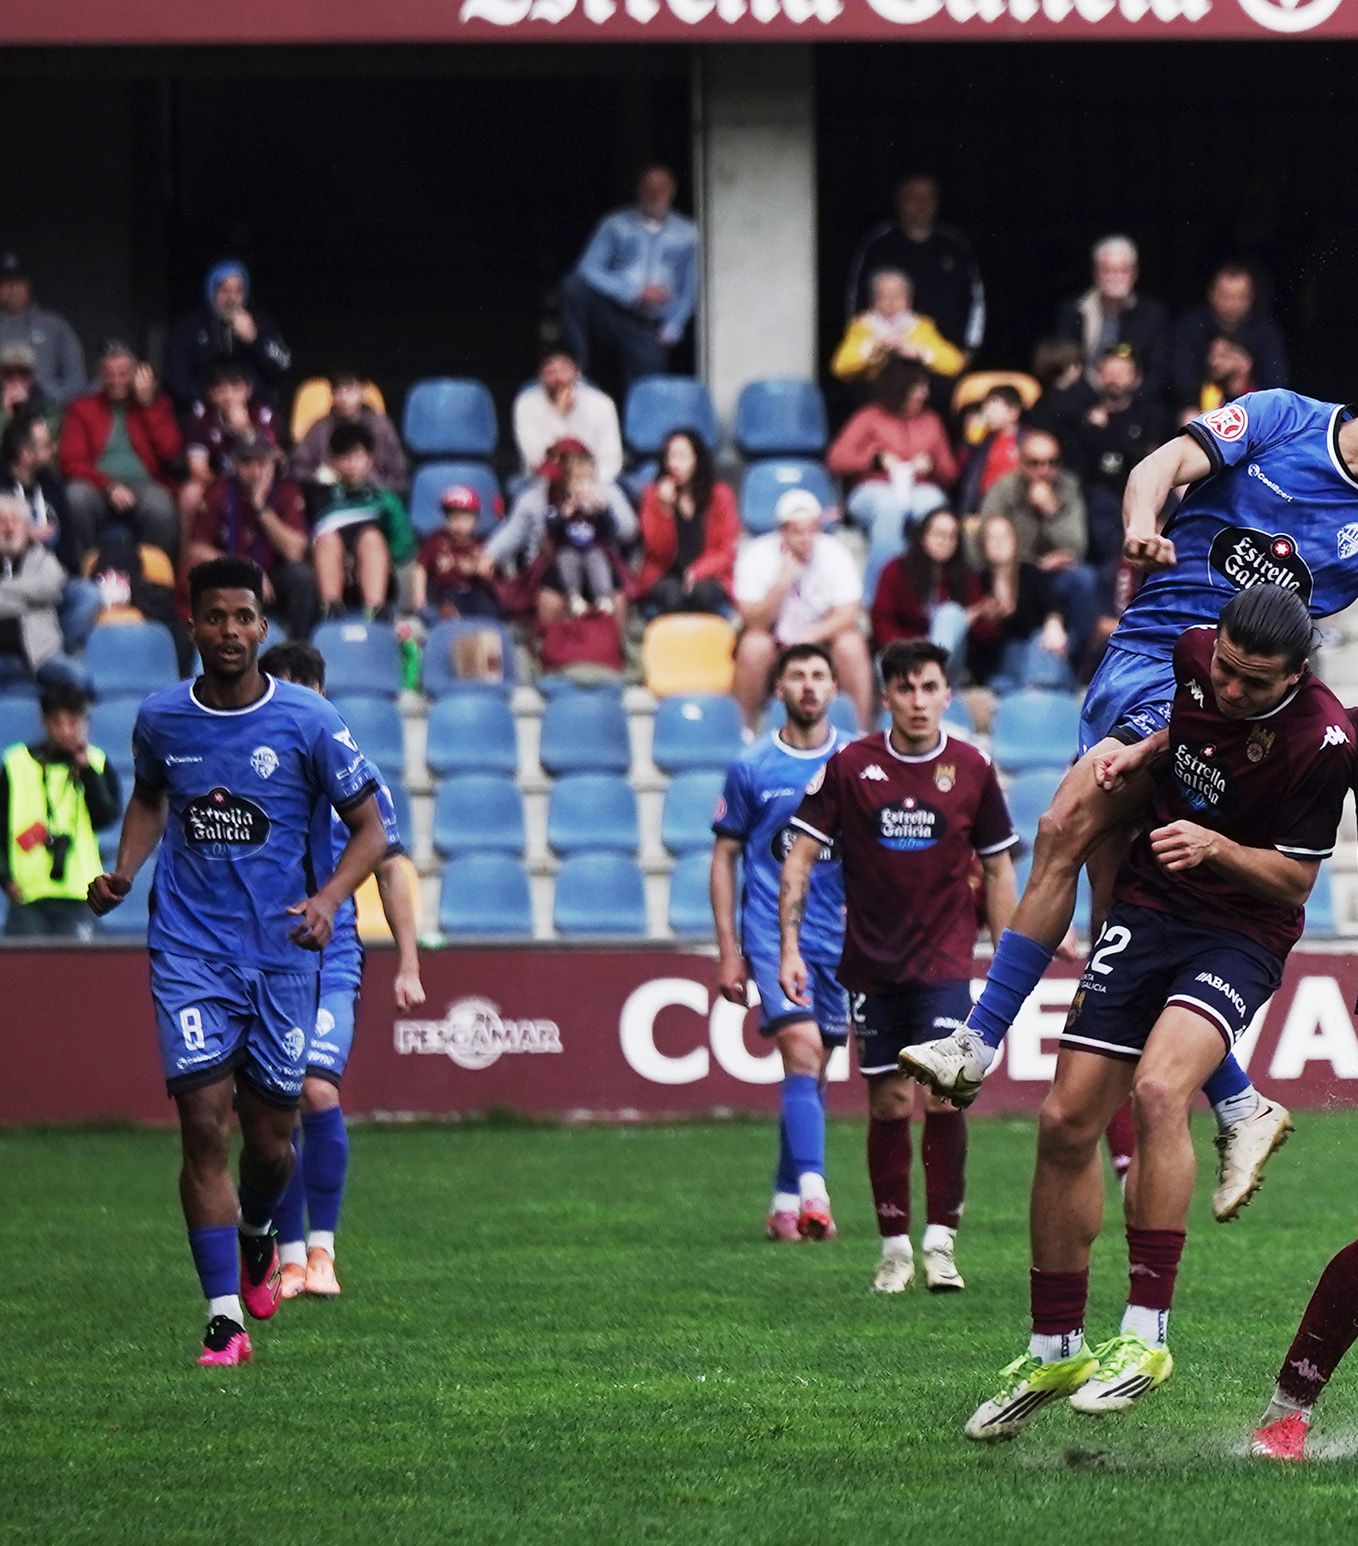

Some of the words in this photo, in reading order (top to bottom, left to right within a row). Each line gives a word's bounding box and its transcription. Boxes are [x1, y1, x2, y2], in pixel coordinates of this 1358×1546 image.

[1174, 744, 1226, 792] Estrella
[1174, 761, 1219, 804] Galicia
[192, 822, 252, 840] Galicia
[881, 808, 936, 825] Estrella
[881, 823, 932, 838] Galicia
[1199, 972, 1247, 1019] ABANCA
[180, 1007, 206, 1051] 8
